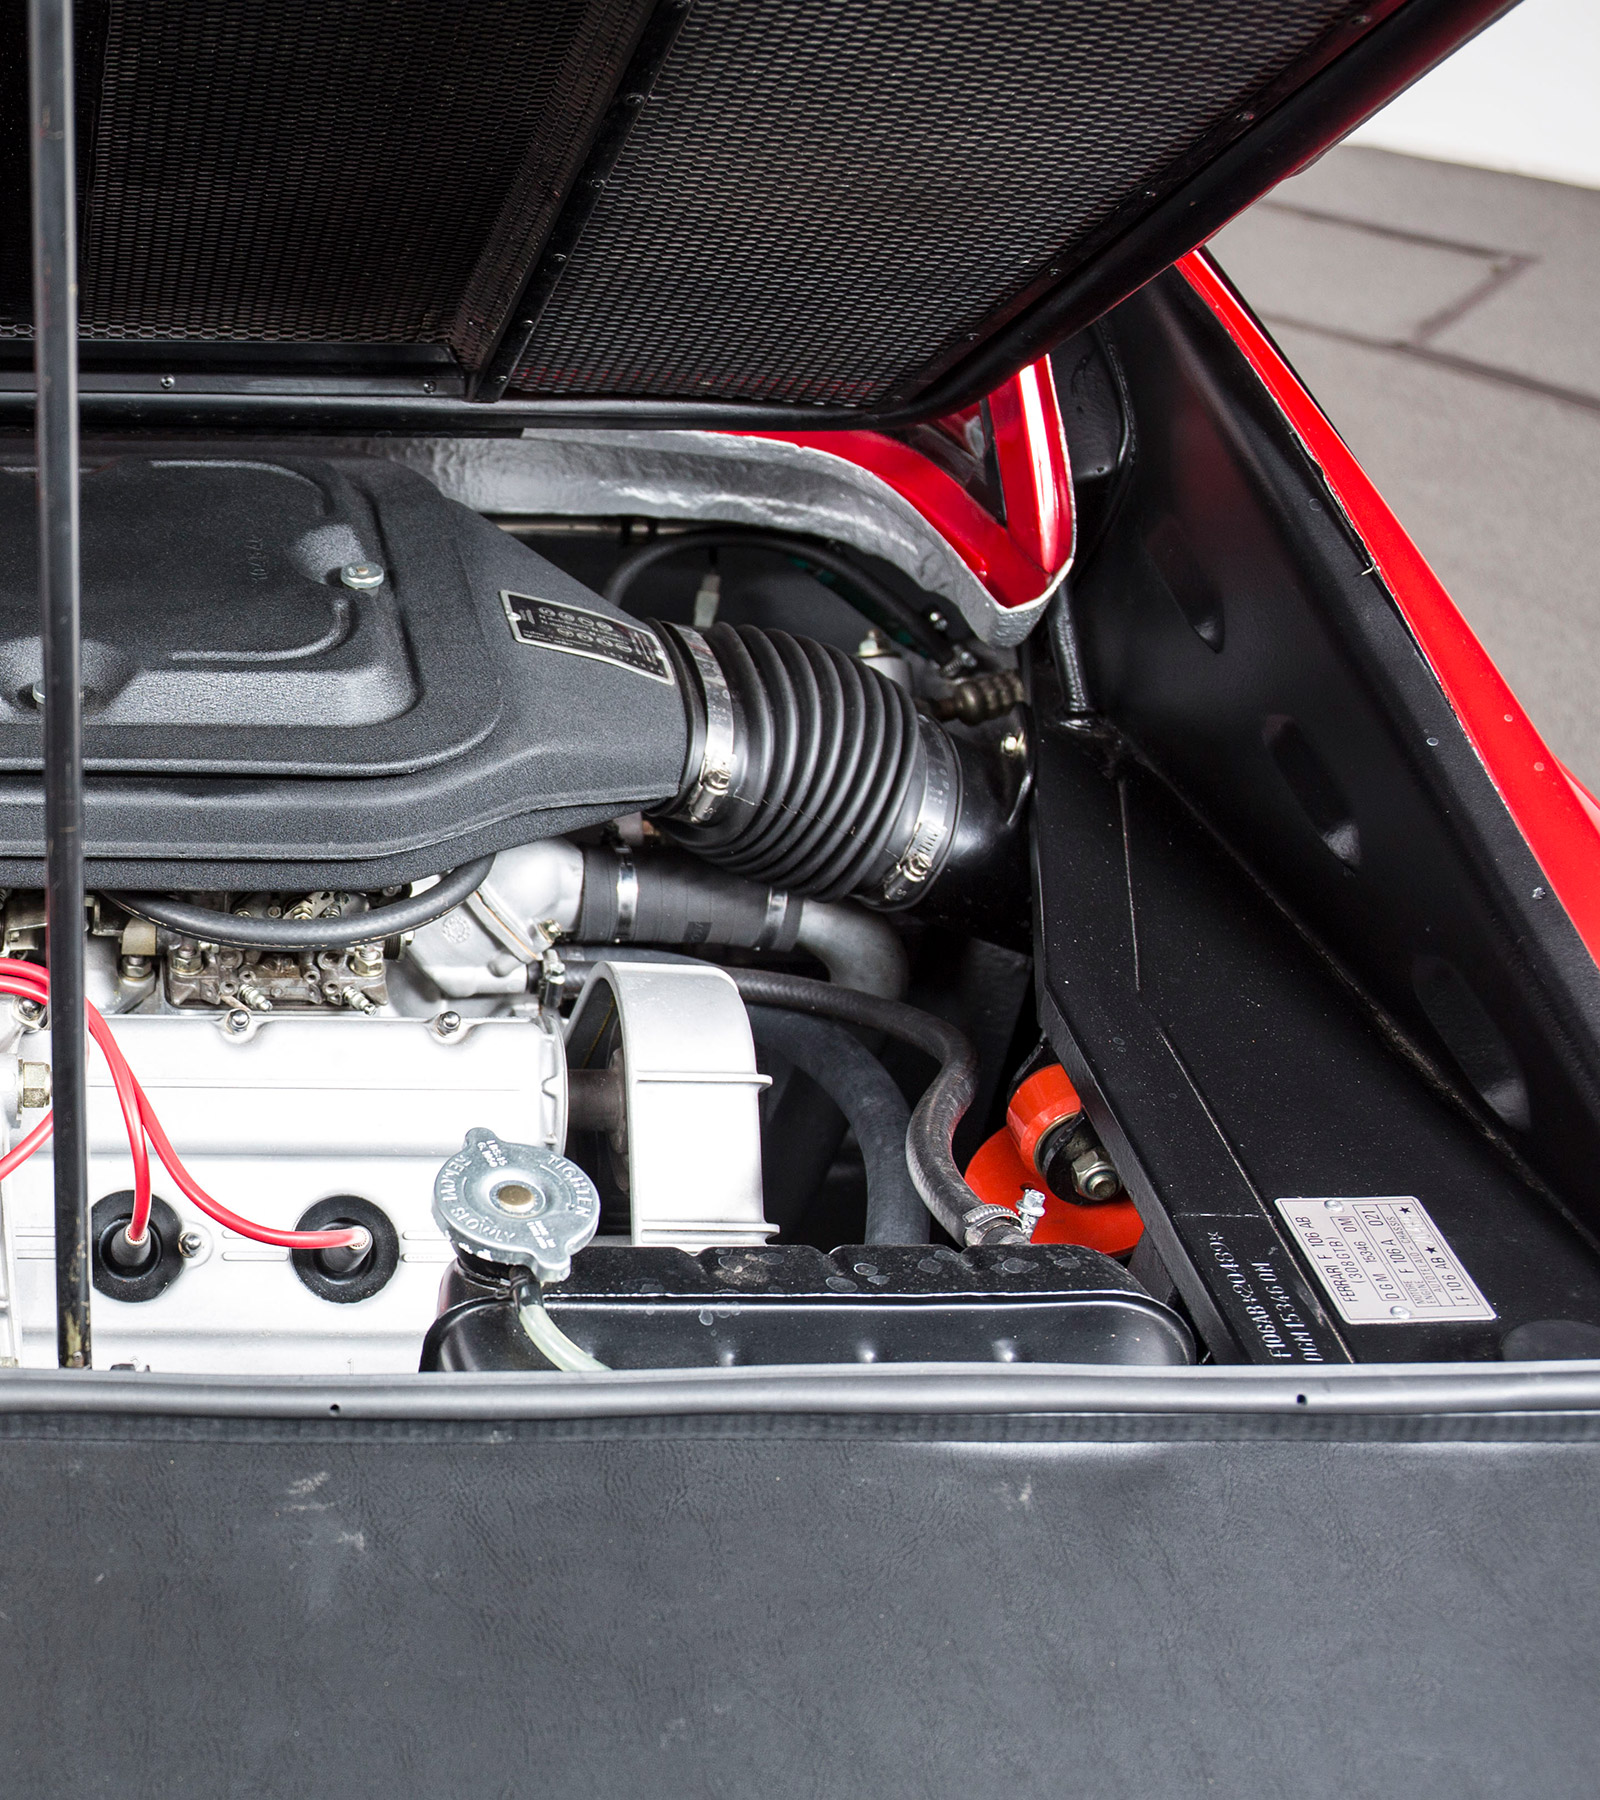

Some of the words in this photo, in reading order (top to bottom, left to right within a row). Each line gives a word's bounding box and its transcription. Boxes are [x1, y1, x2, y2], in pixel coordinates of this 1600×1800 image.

[547, 1154, 593, 1217] TIGHTEN
[451, 1206, 516, 1243] SLOWLY
[1293, 1216, 1314, 1227] AB
[1360, 1210, 1384, 1226] 021
[1385, 1216, 1411, 1243] CHASSIS
[1303, 1232, 1325, 1246] 106
[1352, 1241, 1377, 1262] 15346
[1384, 1248, 1407, 1262] 106
[1429, 1257, 1449, 1268] AB
[1322, 1264, 1358, 1301] FERRARI
[1409, 1252, 1443, 1292] AUTOTELAIO
[1440, 1274, 1464, 1290] 106
[1403, 1280, 1425, 1303] MOTORE
[1413, 1280, 1437, 1303] ENGINE
[1264, 1285, 1305, 1327] 15346
[1289, 1331, 1324, 1360] DGM
